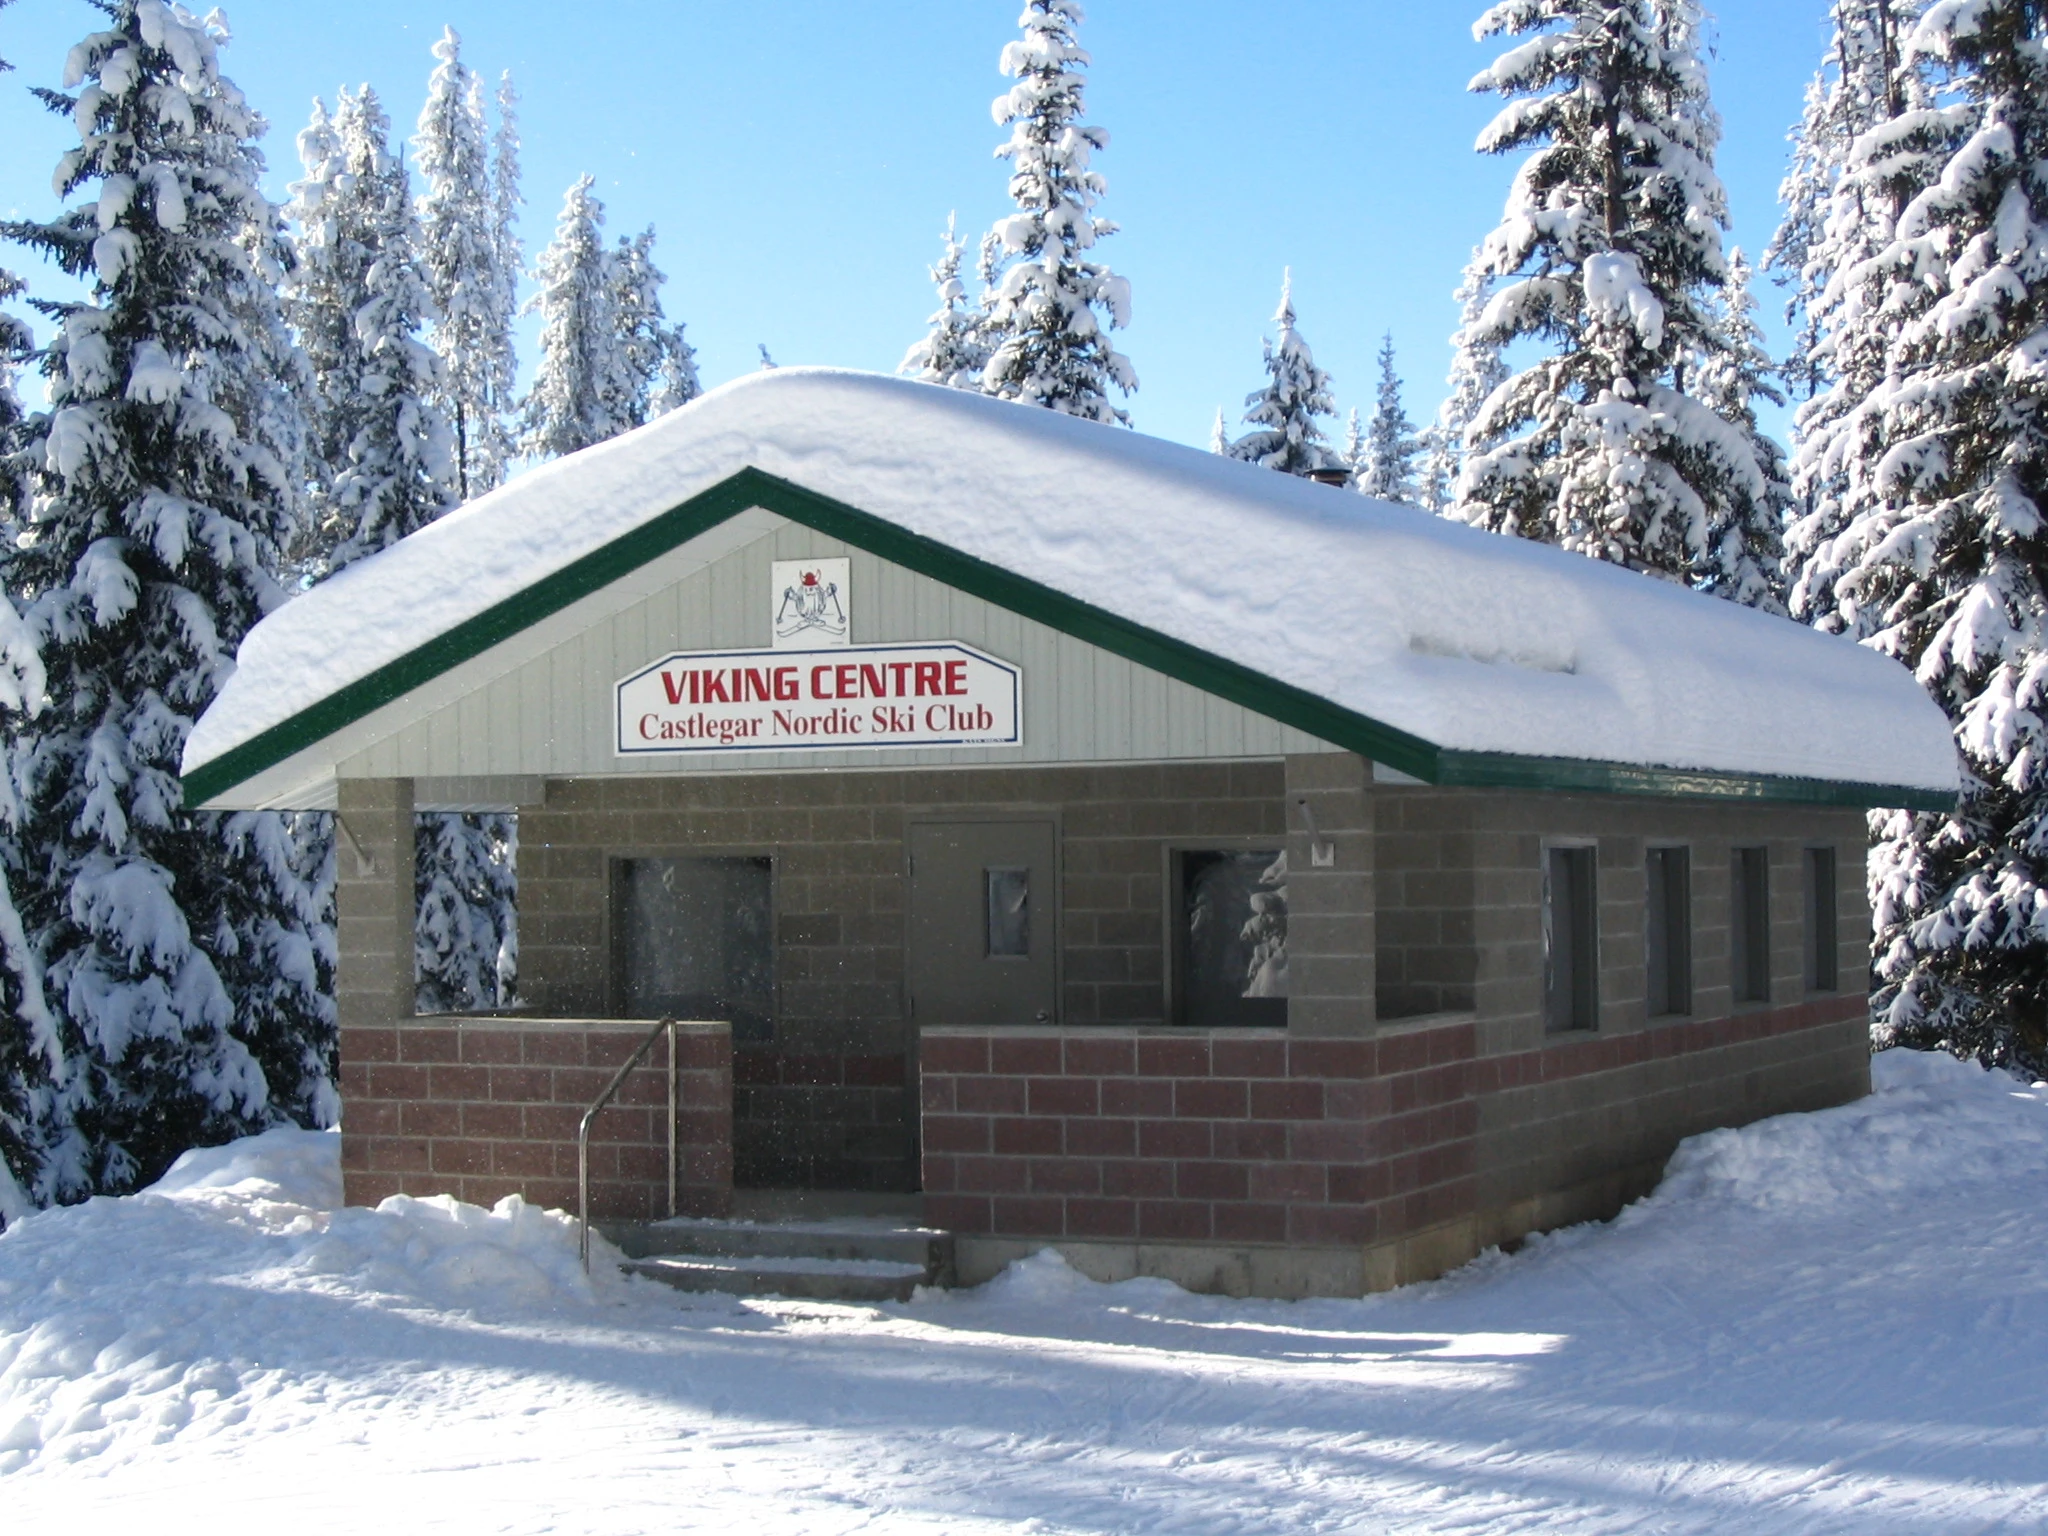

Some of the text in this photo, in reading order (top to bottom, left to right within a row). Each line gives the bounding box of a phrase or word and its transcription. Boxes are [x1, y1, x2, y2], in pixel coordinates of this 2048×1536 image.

[660, 660, 968, 705] VIKING CENTRE
[639, 703, 993, 744] Castlegar Nordic Ski Club
